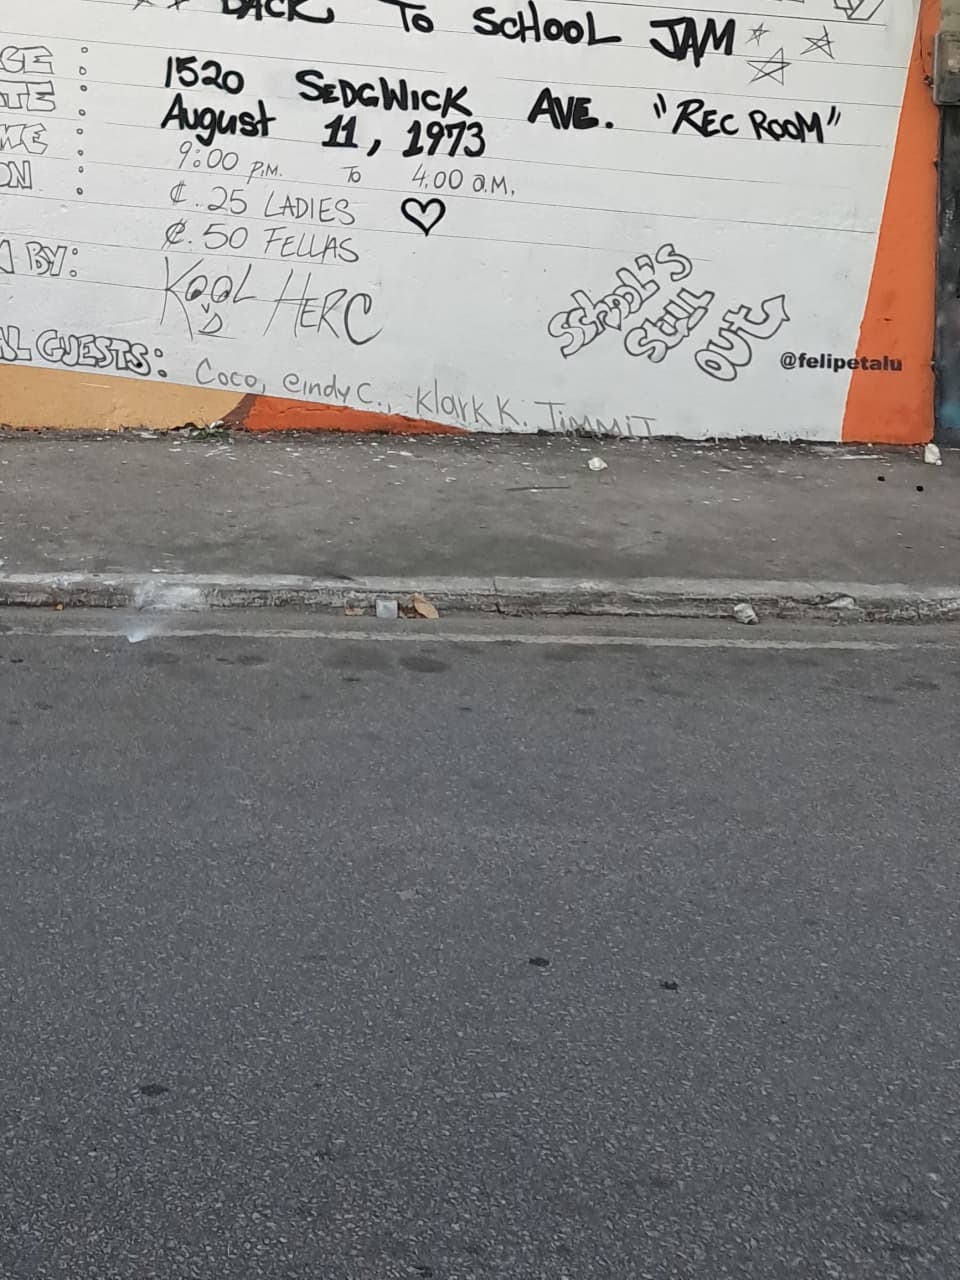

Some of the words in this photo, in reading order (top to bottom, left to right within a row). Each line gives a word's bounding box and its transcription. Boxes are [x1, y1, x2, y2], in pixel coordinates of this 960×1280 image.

[650, 17, 736, 67] JAM
[164, 55, 245, 95] 1520
[296, 70, 473, 117] SEDGWICK
[527, 87, 614, 130] AVE.
[161, 92, 277, 147] August
[402, 120, 486, 158] 1973
[178, 140, 240, 171] 9:00
[263, 190, 356, 225] LADIES
[263, 226, 360, 264] FELLAS
[159, 256, 257, 342] KOOL
[262, 268, 384, 346] HERC
[780, 351, 903, 373] @felipetalu
